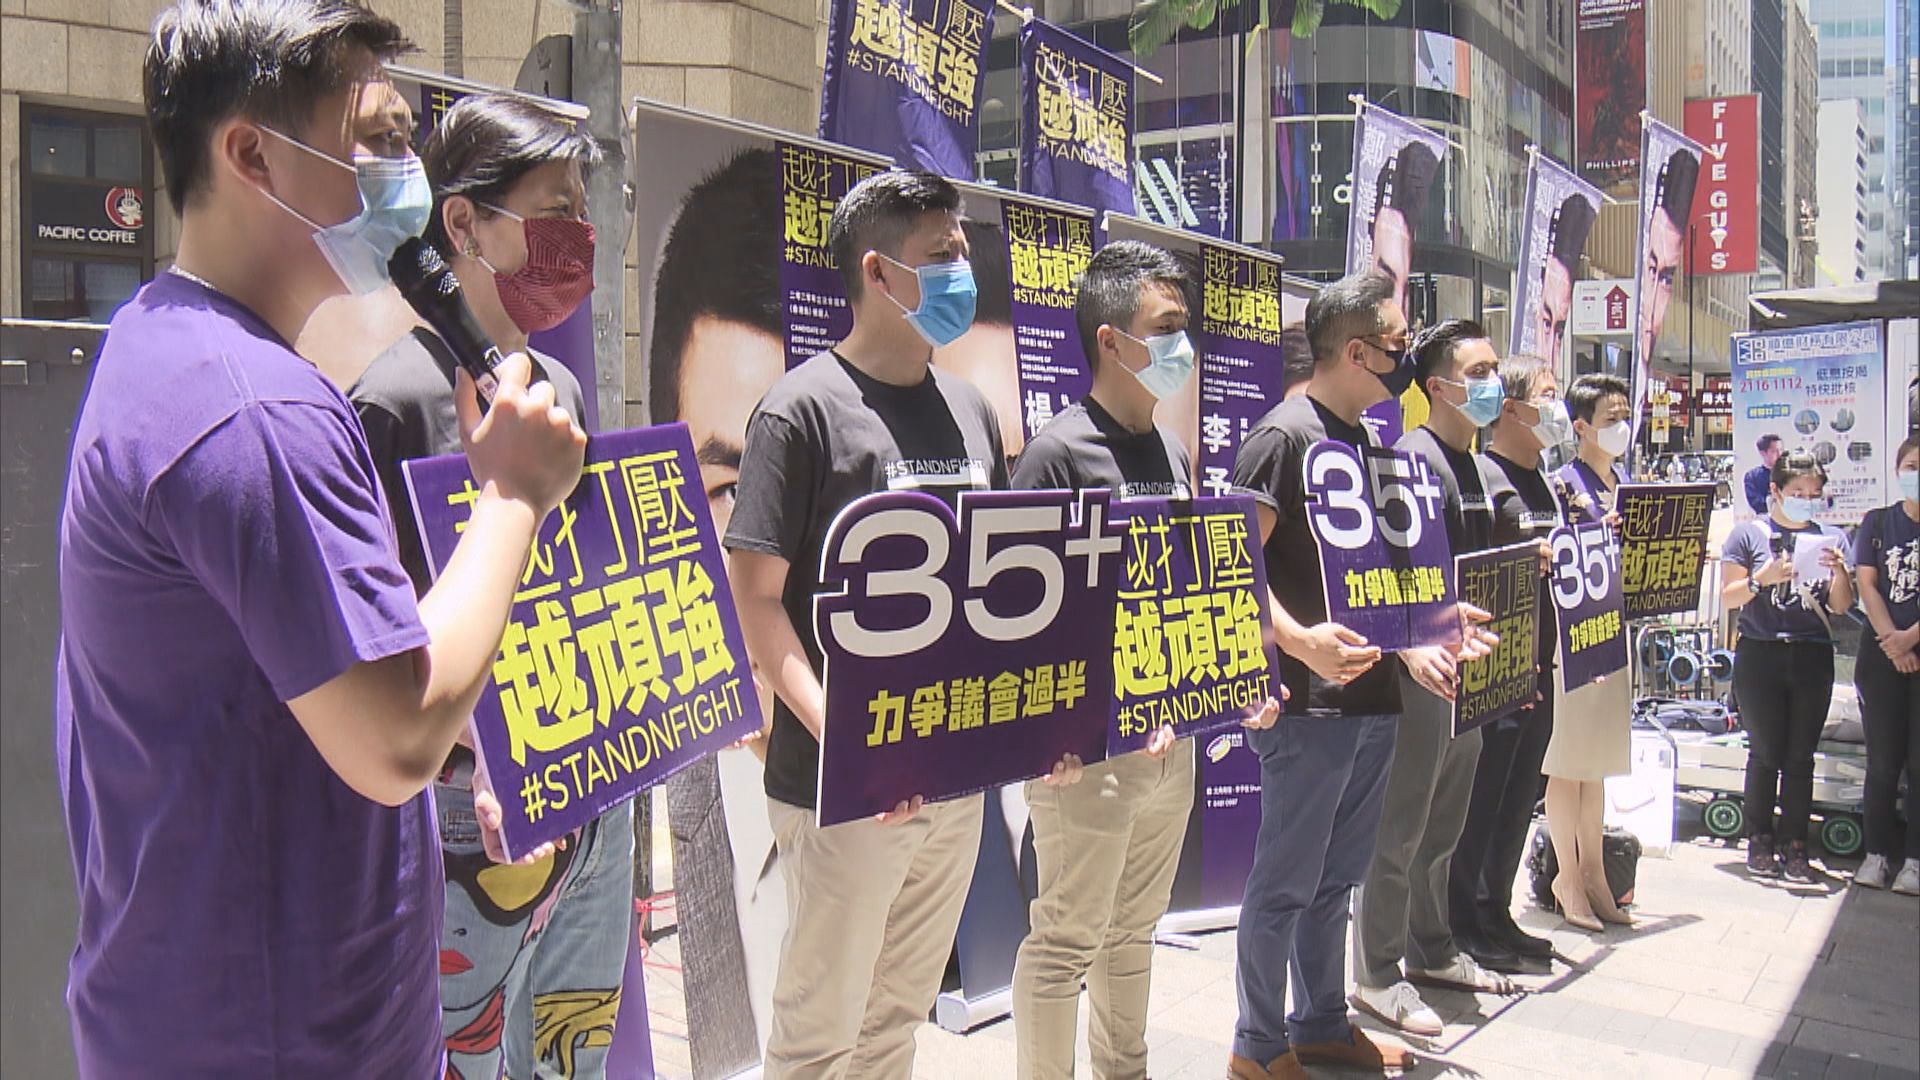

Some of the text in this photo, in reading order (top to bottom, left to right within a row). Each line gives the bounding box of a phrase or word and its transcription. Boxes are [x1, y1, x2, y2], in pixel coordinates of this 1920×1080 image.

[847, 49, 973, 128] #STANDNFIGHT
[1586, 158, 1636, 170] PHILLIPS
[1710, 101, 1729, 270] FIVE GUYS
[38, 224, 136, 243] PACIFIC COFFEE
[1006, 204, 1093, 256] 越打壓
[1203, 247, 1279, 293] 越打壓
[1202, 319, 1281, 347] #STANDNFIGHT
[1203, 280, 1281, 333] 越頑強
[1740, 377, 1802, 394] 2116 1112
[1311, 450, 1441, 550] 35+
[1621, 493, 1708, 541] 越打壓
[829, 502, 1123, 658] 35+
[1344, 565, 1446, 609] 力爭議會過半
[1553, 528, 1620, 610] 35+
[1621, 538, 1700, 593] 越頑強
[492, 560, 736, 767] 越頑強
[1113, 588, 1269, 701] 越頑強
[865, 659, 1087, 748] 力爭議會過半
[1117, 673, 1271, 738] #STANDNFIGHT
[1461, 674, 1533, 729] #STANDNFIGHT
[520, 677, 745, 825] #STANDNFIGHT
